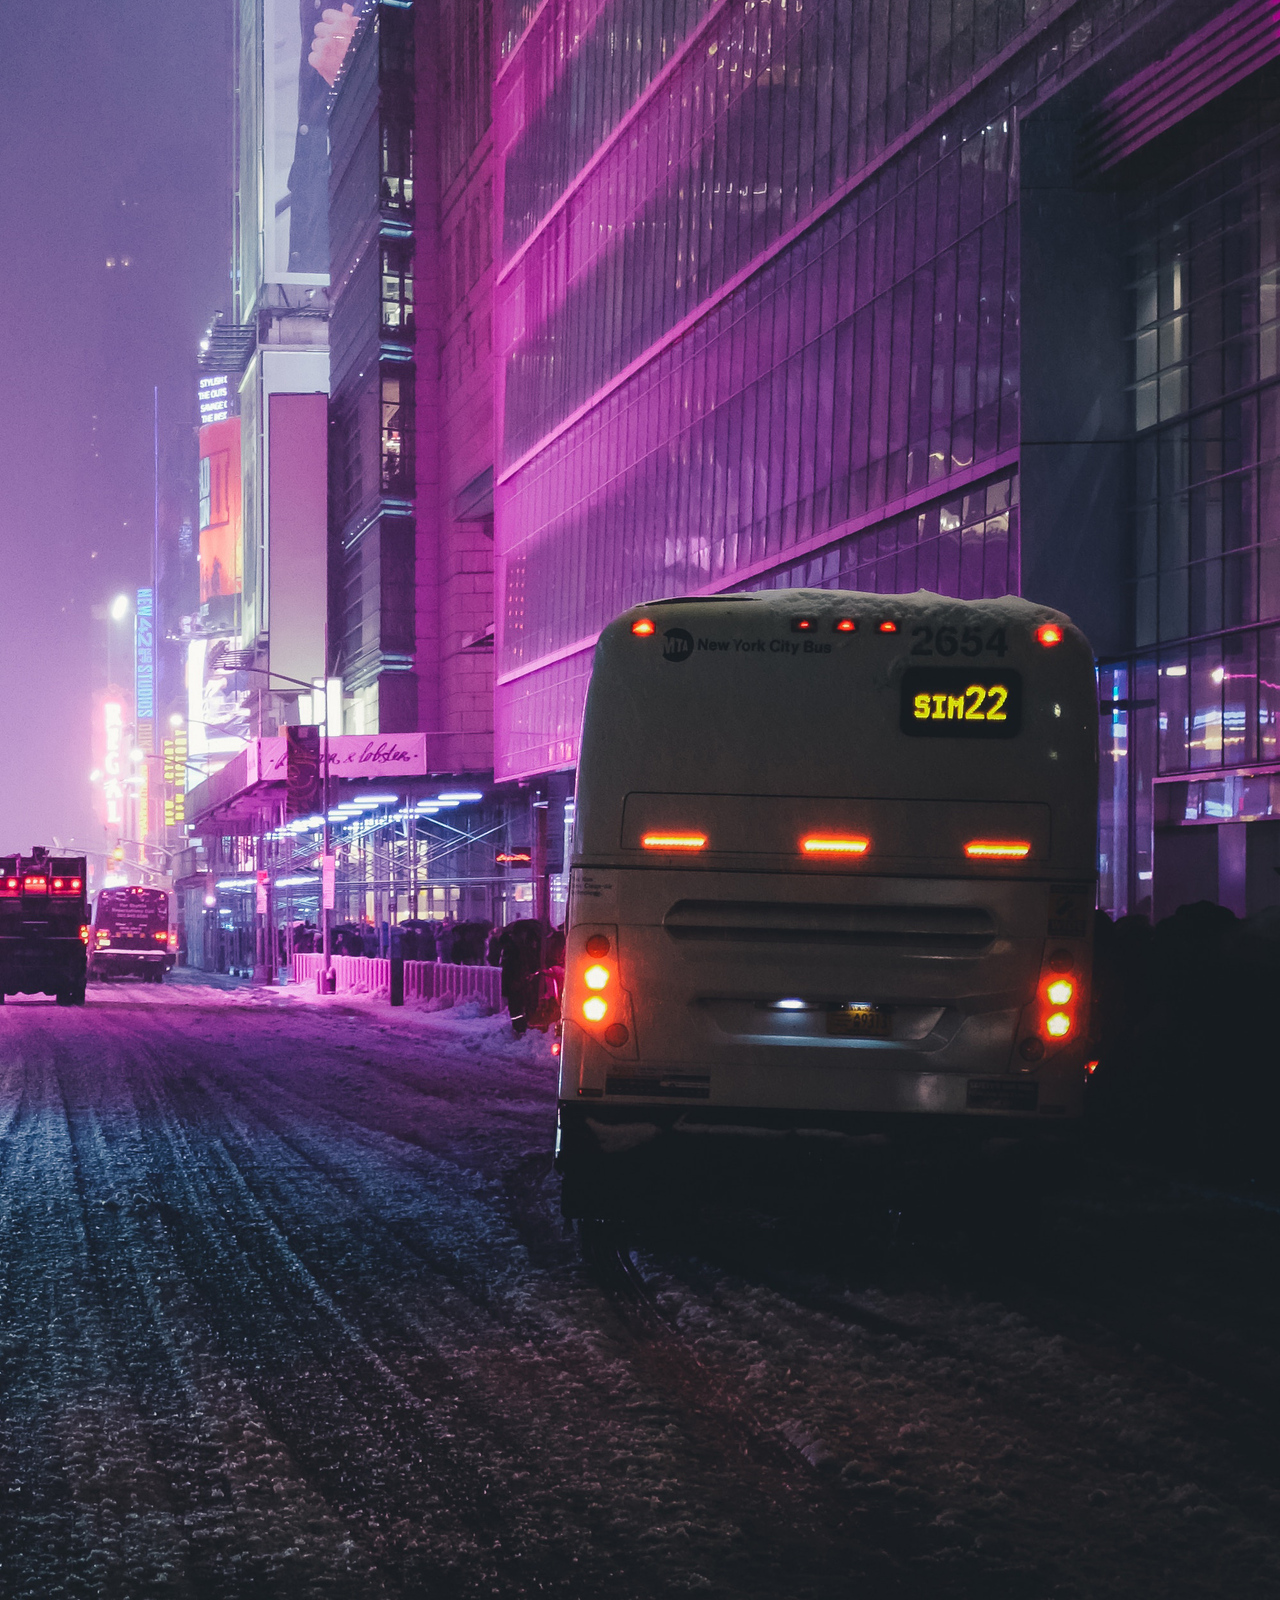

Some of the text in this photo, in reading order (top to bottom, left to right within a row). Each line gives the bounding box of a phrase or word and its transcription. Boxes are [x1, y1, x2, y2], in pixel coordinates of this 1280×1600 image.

[198, 391, 210, 400] THE
[137, 588, 152, 616] NEW
[697, 638, 729, 651] New
[733, 639, 766, 652] York
[770, 640, 800, 655] City
[803, 641, 832, 654] Bus
[910, 626, 1009, 657] 2654
[137, 664, 153, 717] STUDIOS
[913, 685, 1009, 721] SIM22
